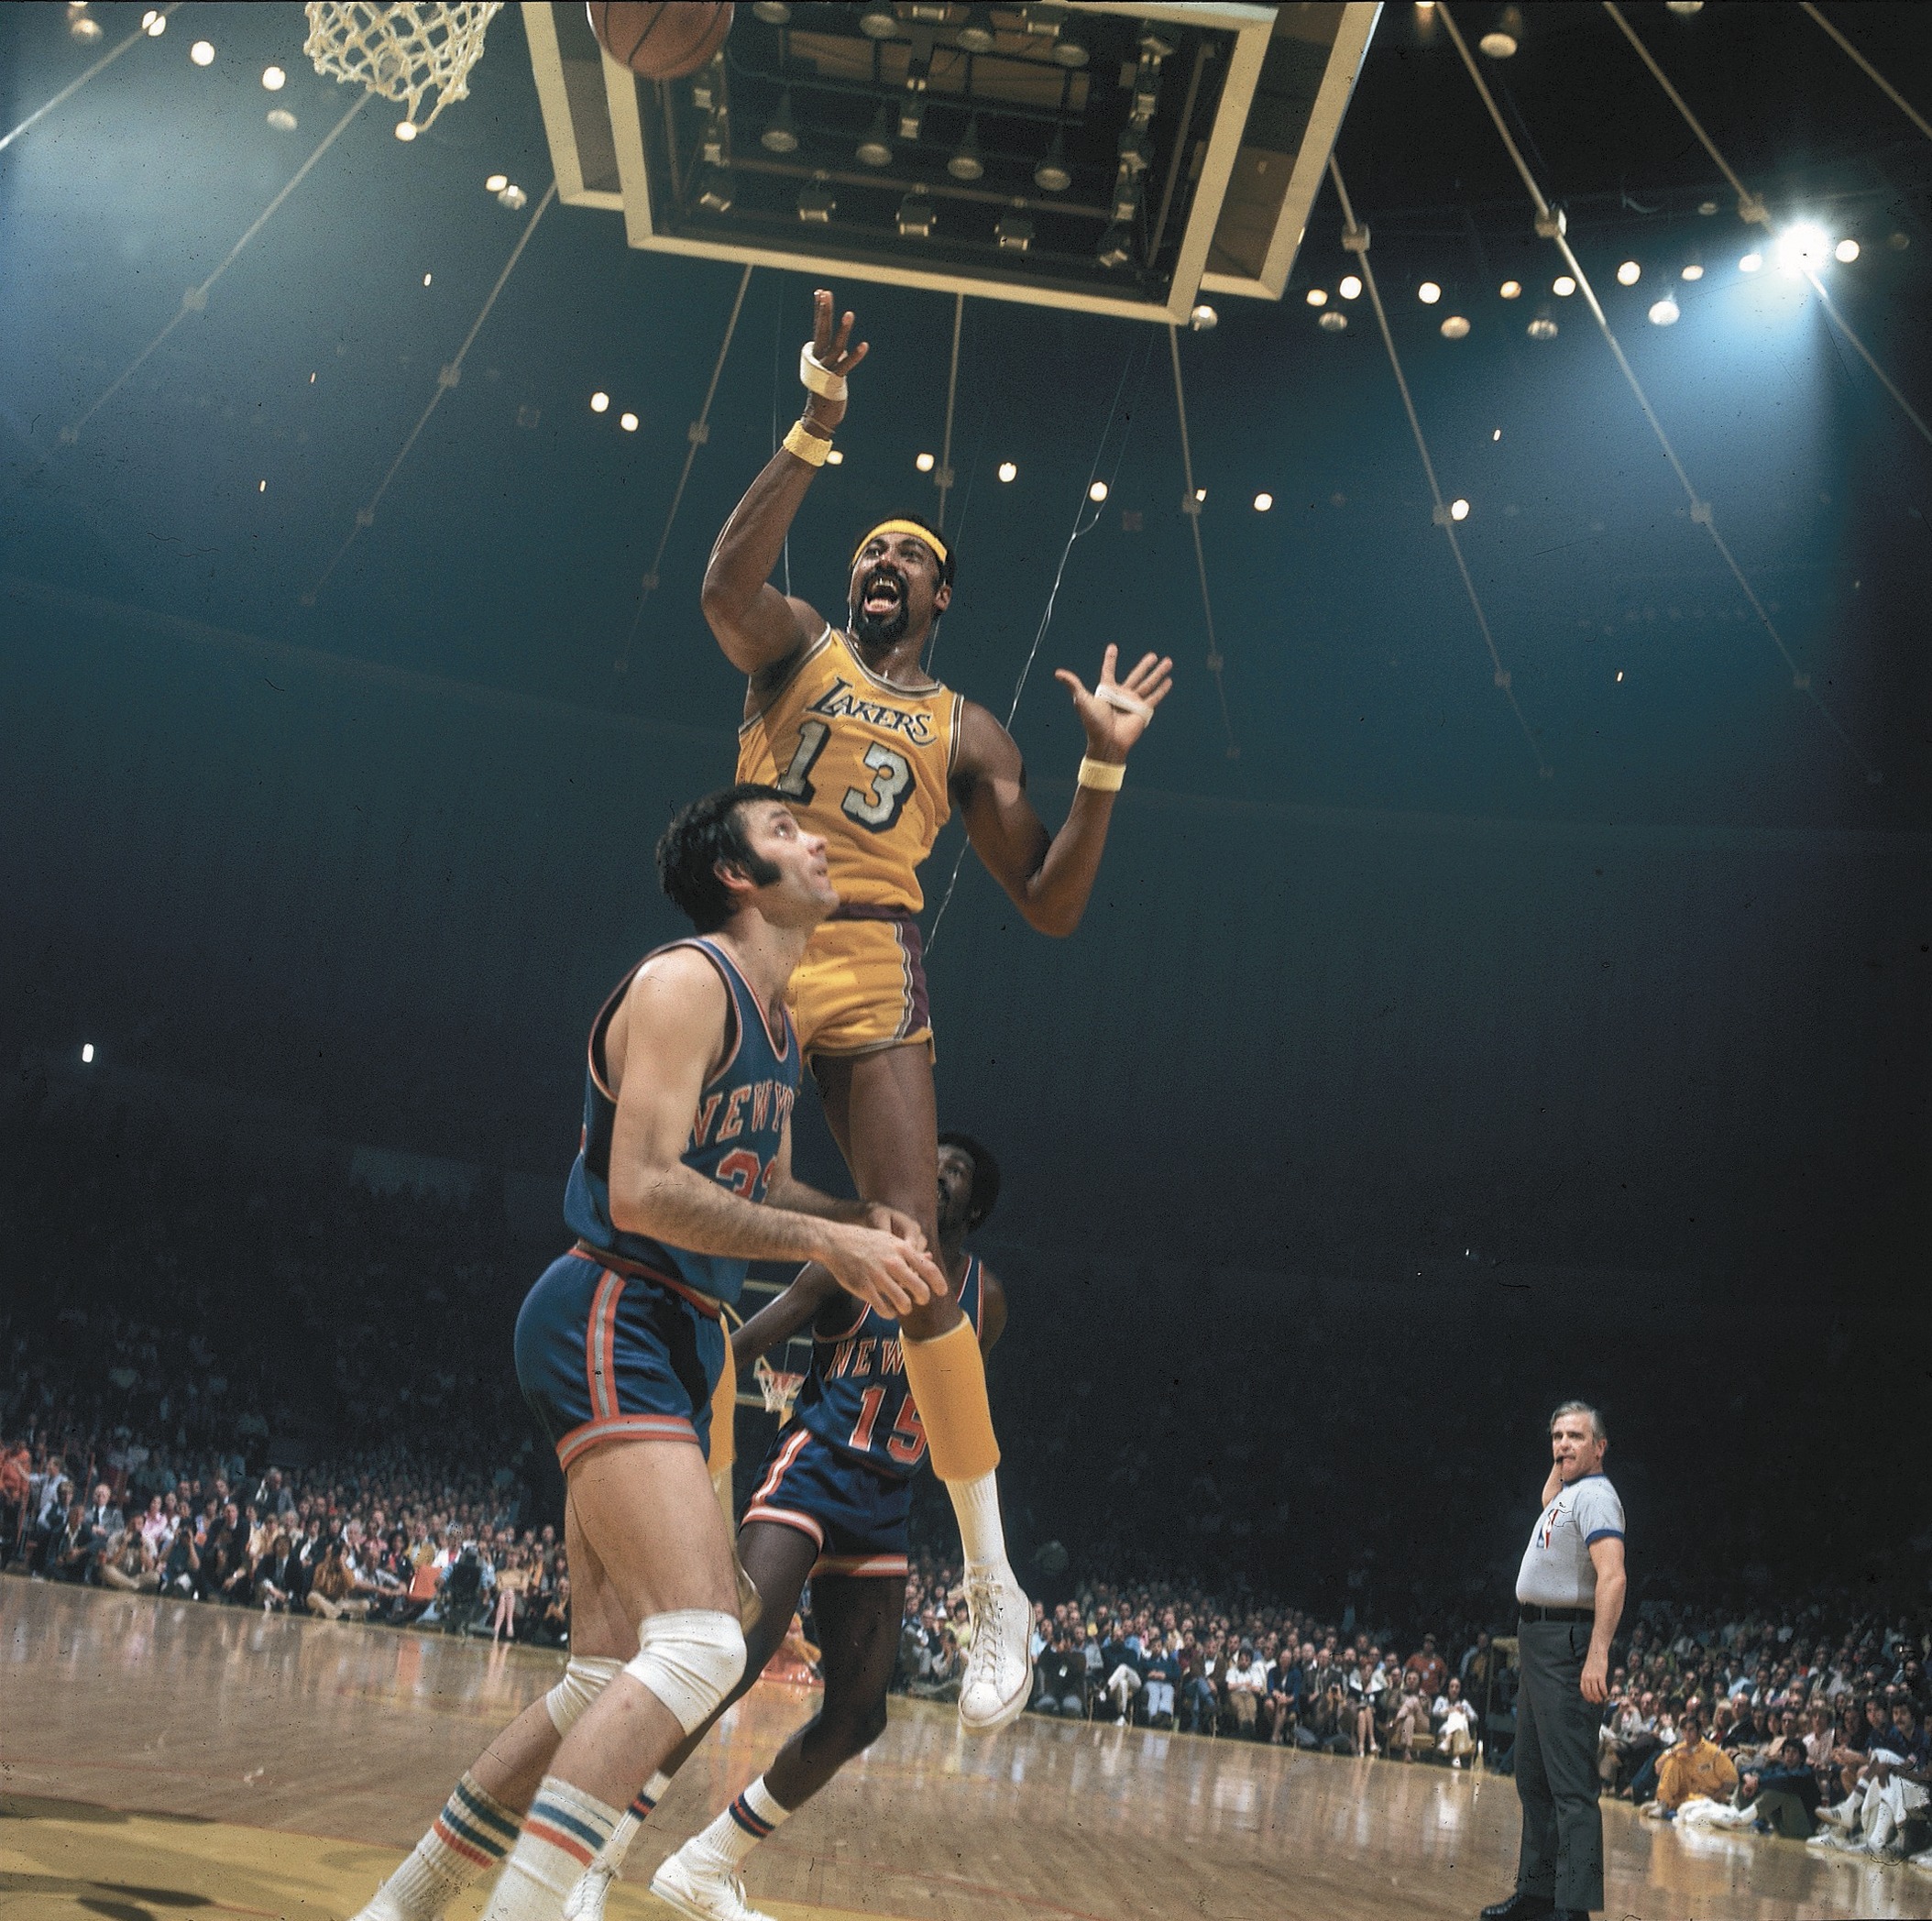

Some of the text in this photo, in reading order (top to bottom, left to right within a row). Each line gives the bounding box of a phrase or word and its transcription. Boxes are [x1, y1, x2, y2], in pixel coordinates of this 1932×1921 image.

[805, 676, 937, 747] LAKERS
[778, 719, 917, 835] 13
[826, 1337, 906, 1379] NEW
[850, 1383, 927, 1465] 15
